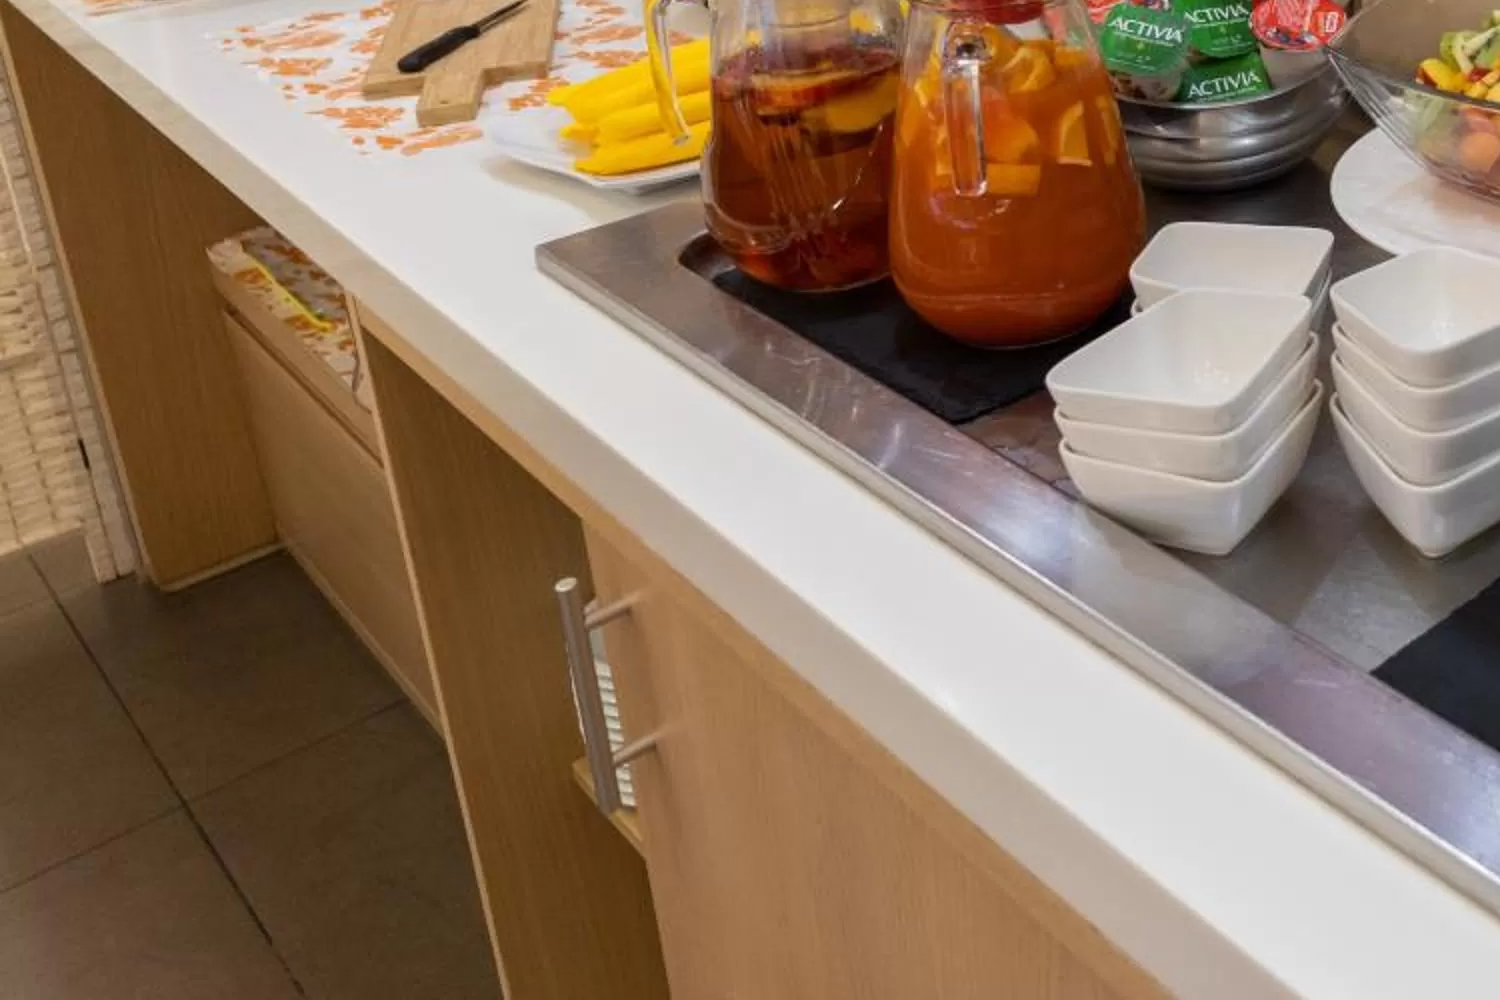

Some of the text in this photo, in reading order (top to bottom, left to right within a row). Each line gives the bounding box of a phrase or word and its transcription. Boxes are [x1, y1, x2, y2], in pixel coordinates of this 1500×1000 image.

[1183, 2, 1249, 23] ACTIVIA
[1107, 16, 1183, 43] ACTIVIA
[1187, 71, 1263, 99] ACTIVIA
